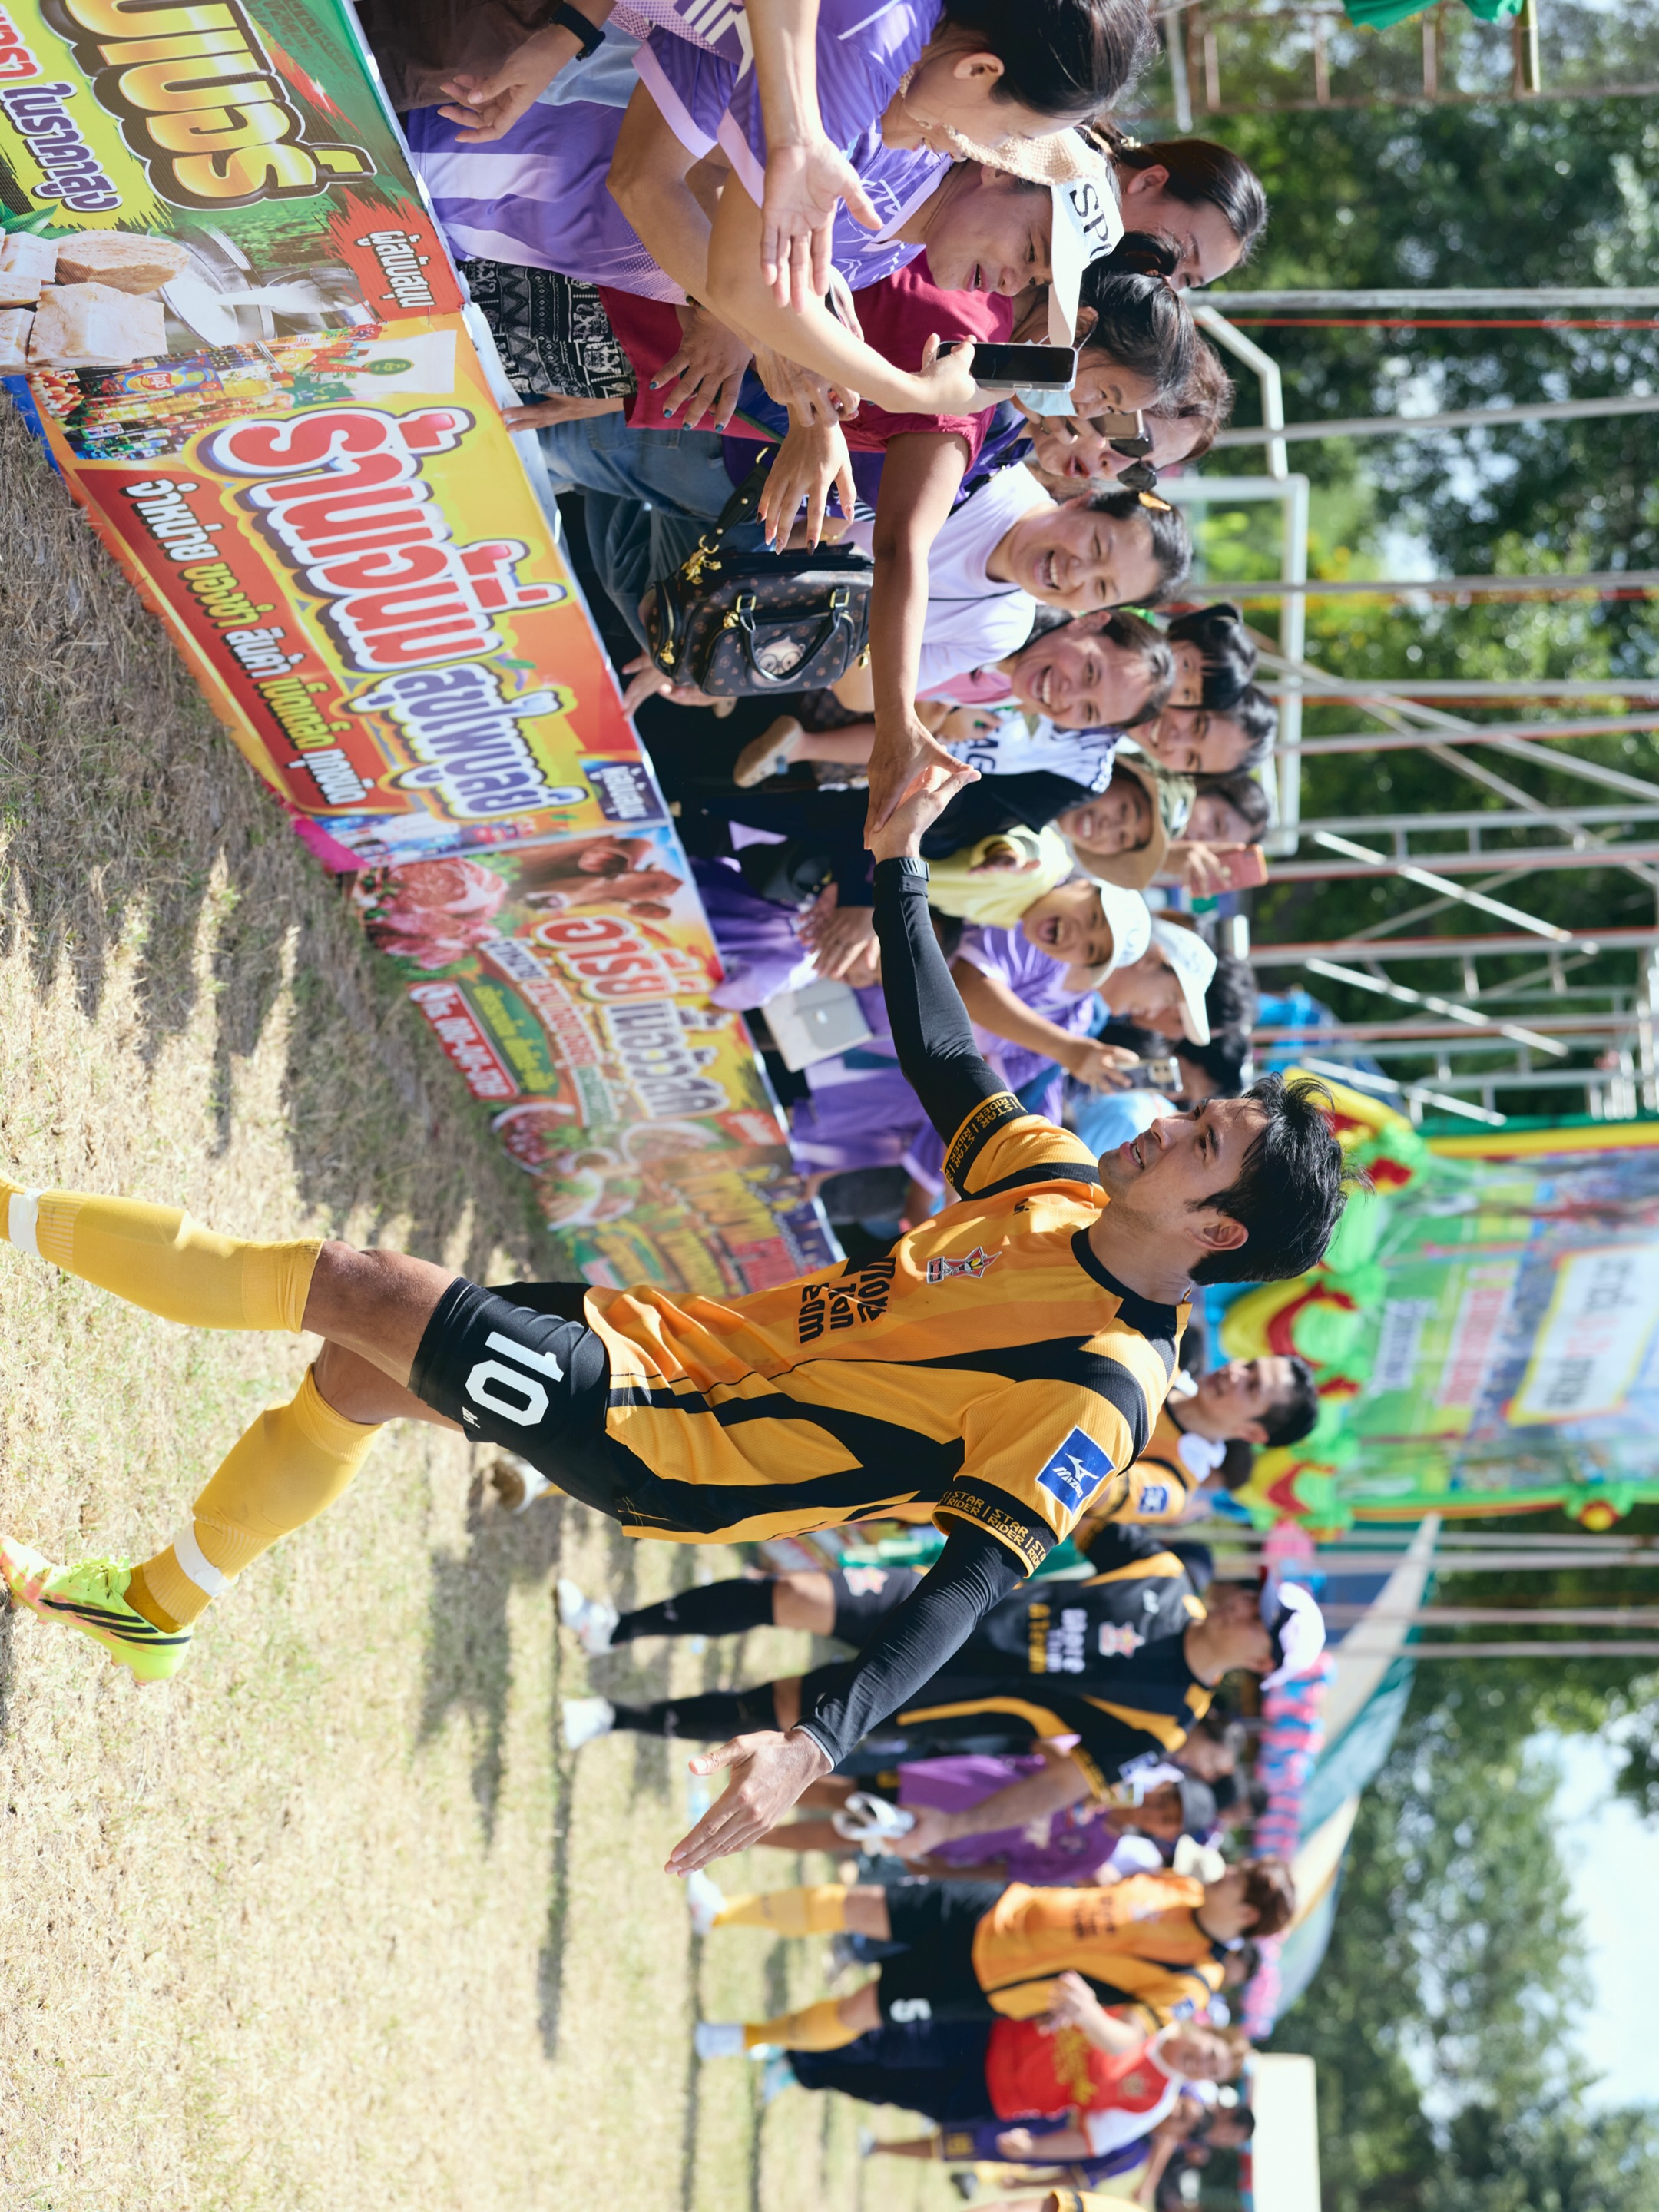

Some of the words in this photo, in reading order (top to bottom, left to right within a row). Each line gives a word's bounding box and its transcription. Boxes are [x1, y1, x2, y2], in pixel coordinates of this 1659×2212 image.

[2, 82, 121, 211] ในราคาสูง
[356, 230, 436, 308] ผู้สนับสนุน
[124, 478, 224, 562] จำหน่าย
[181, 563, 274, 629] ของชำ
[224, 627, 304, 679] สินค้า
[257, 677, 352, 750] เบ็ดเตล็ด
[360, 666, 585, 815] สุขไพบูลย์
[288, 749, 376, 805] ทุกชนิด
[589, 766, 648, 820] ผู้สนับสนุน
[541, 919, 704, 997] อารีย์
[609, 1002, 730, 1118] เนื้อวัวสด
[975, 1097, 1008, 1122] RIDER
[980, 1103, 1014, 1128] STAR
[949, 1128, 971, 1163] RIDER
[955, 1133, 975, 1168] STAR
[465, 1331, 565, 1426] 10
[946, 1498, 981, 1517] RIDER
[986, 1515, 1025, 1546] RIDER
[952, 1491, 987, 1508] STAR
[992, 1508, 1030, 1538] STAR
[1060, 1608, 1088, 1674] More
[889, 1997, 932, 2024] 5
